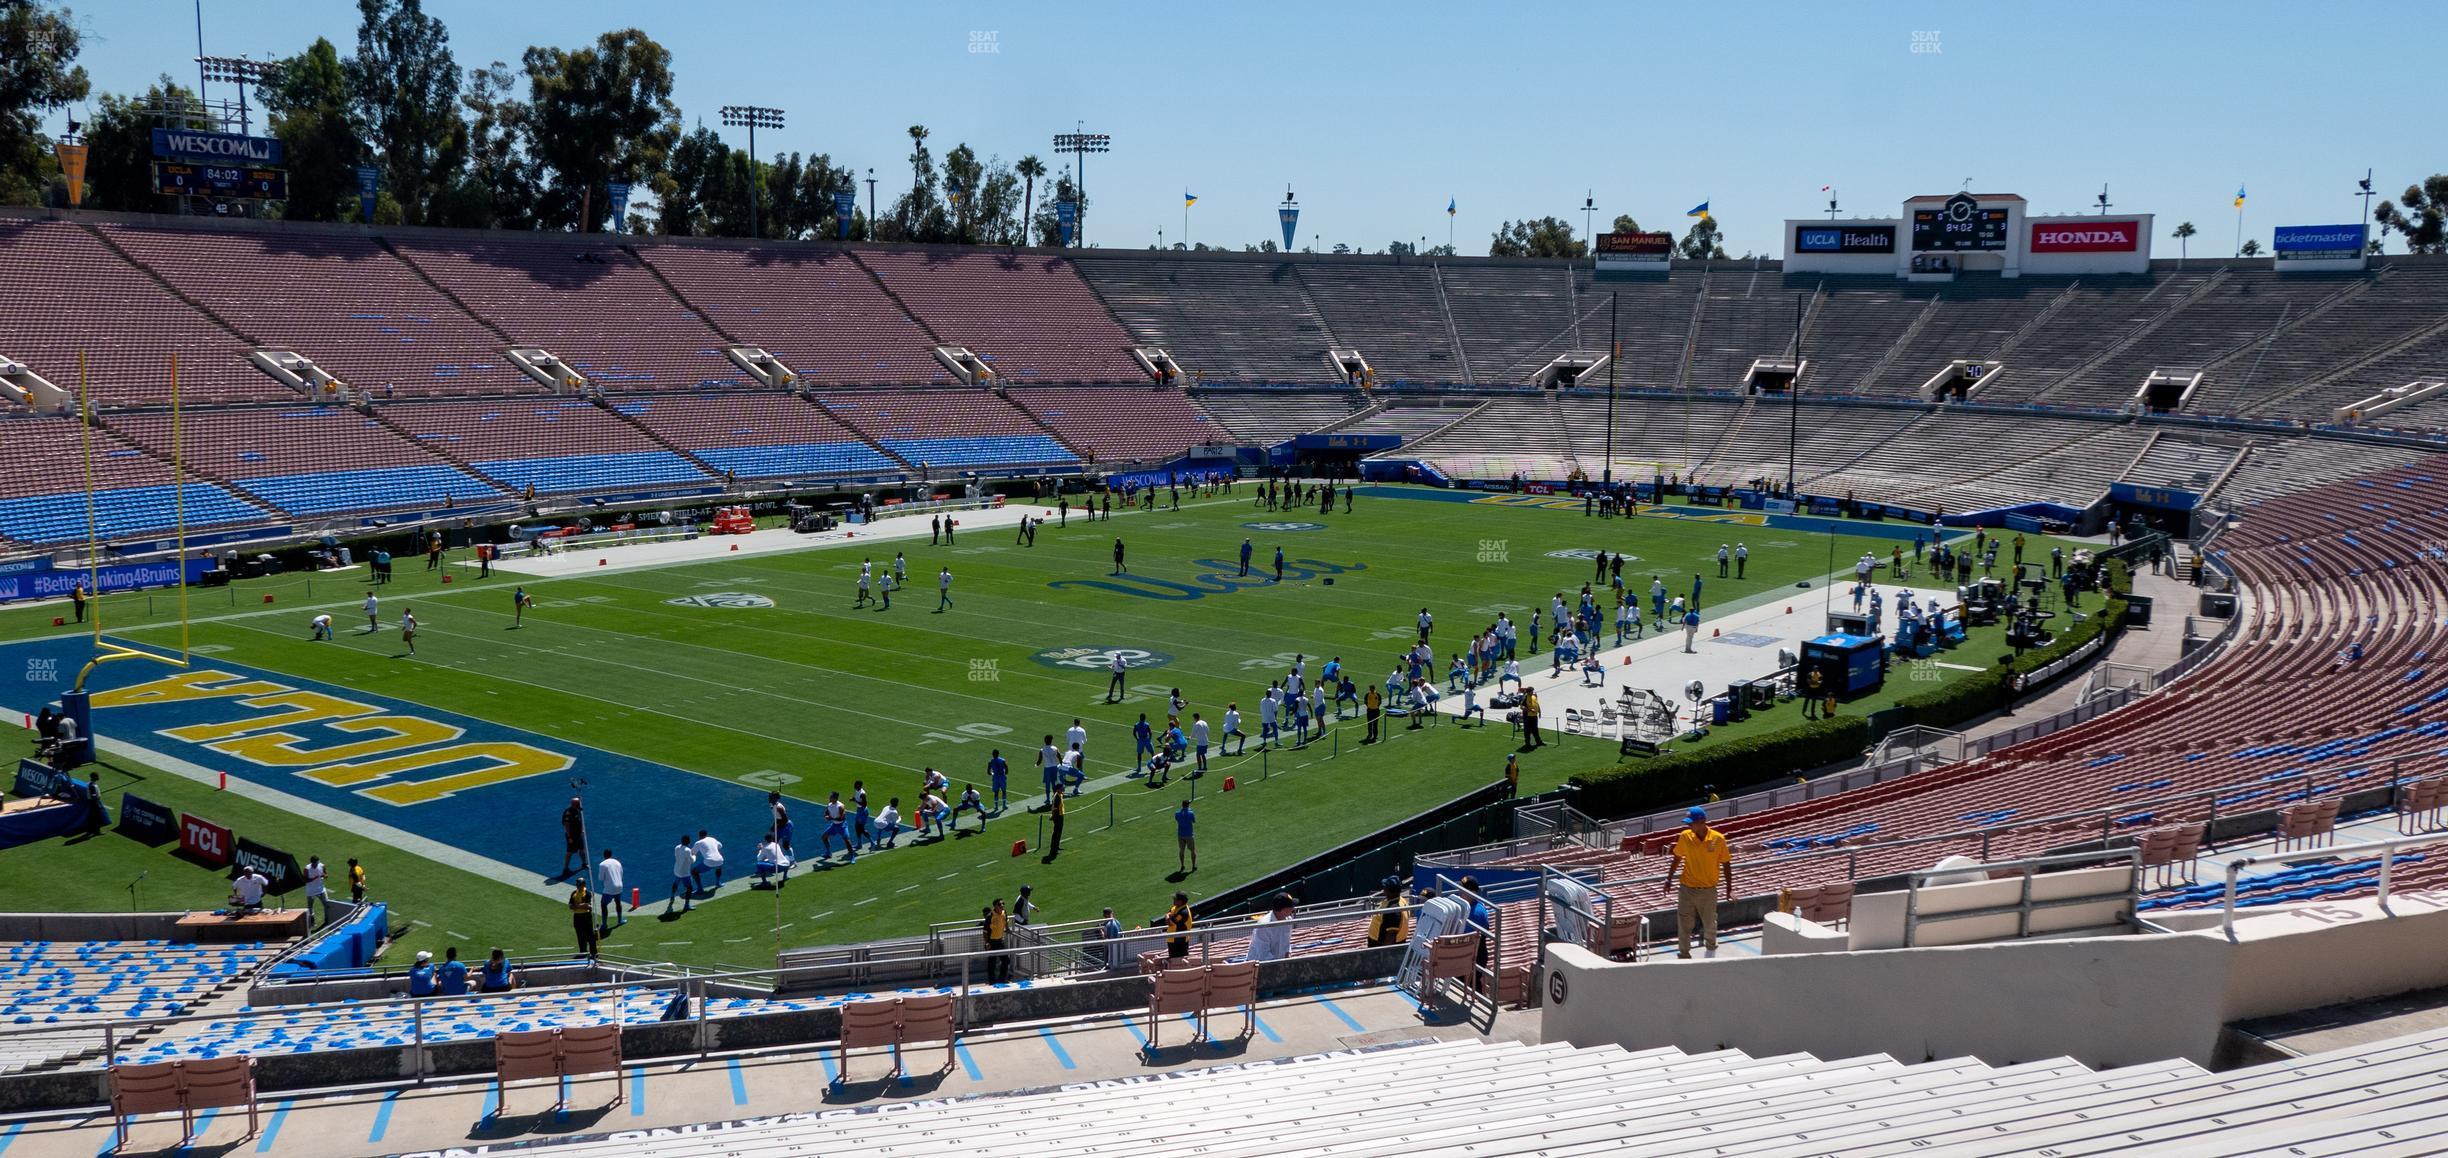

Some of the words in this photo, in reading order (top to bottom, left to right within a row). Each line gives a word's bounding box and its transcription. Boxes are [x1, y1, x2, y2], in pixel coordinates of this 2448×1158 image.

[167, 134, 249, 157] WESCOM
[176, 175, 184, 186] 0
[206, 168, 239, 181] 84:02
[261, 181, 269, 192] 0
[1611, 237, 1629, 245] SAN
[1631, 237, 1668, 245] MANUEL
[1806, 234, 1836, 245] UCLA
[1844, 233, 1888, 247] Health
[2039, 231, 2129, 245] HONDA
[2276, 232, 2356, 244] ticketmaster
[1966, 365, 1982, 378] 40
[1529, 485, 1550, 494] TCL
[755, 502, 778, 511] BOWL
[34, 566, 181, 594] #BetteBnking4Bruins
[50, 669, 577, 807] UCLA
[187, 822, 222, 856] TCL
[235, 849, 286, 881] NISSAN
[2289, 905, 2363, 925] 15
[1551, 977, 1565, 999] 15
[1910, 1138, 1933, 1147] 10
